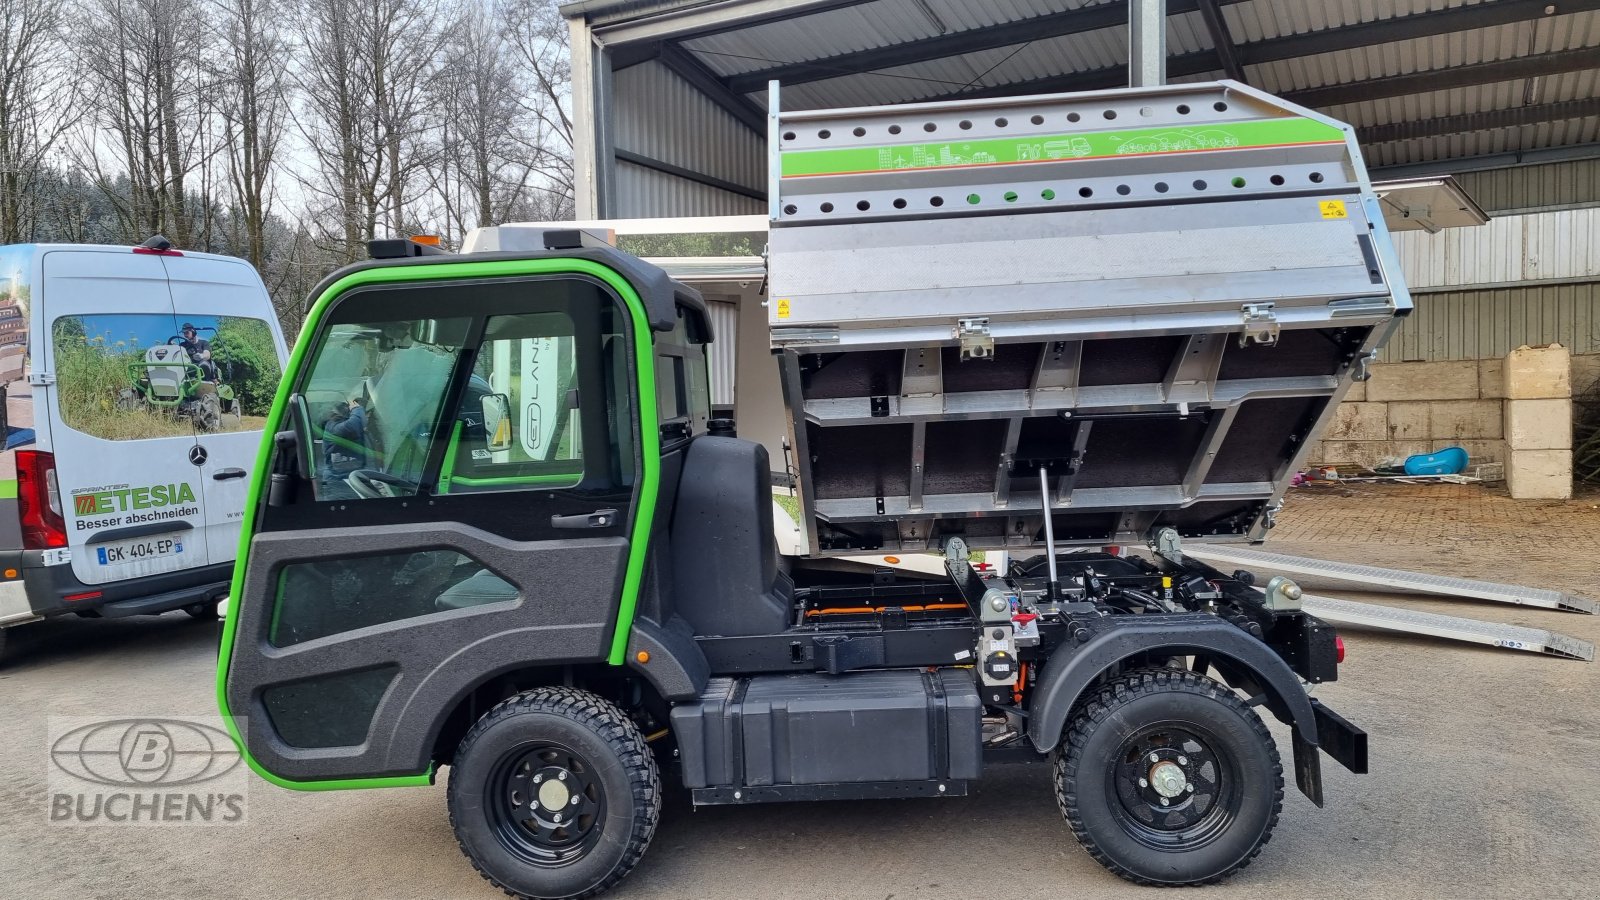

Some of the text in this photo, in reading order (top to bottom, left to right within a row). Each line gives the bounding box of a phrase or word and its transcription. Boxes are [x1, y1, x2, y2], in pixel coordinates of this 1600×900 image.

[70, 484, 129, 494] SPRINTER
[73, 483, 196, 517] ETESIA
[76, 506, 199, 531] Besser abschneiden
